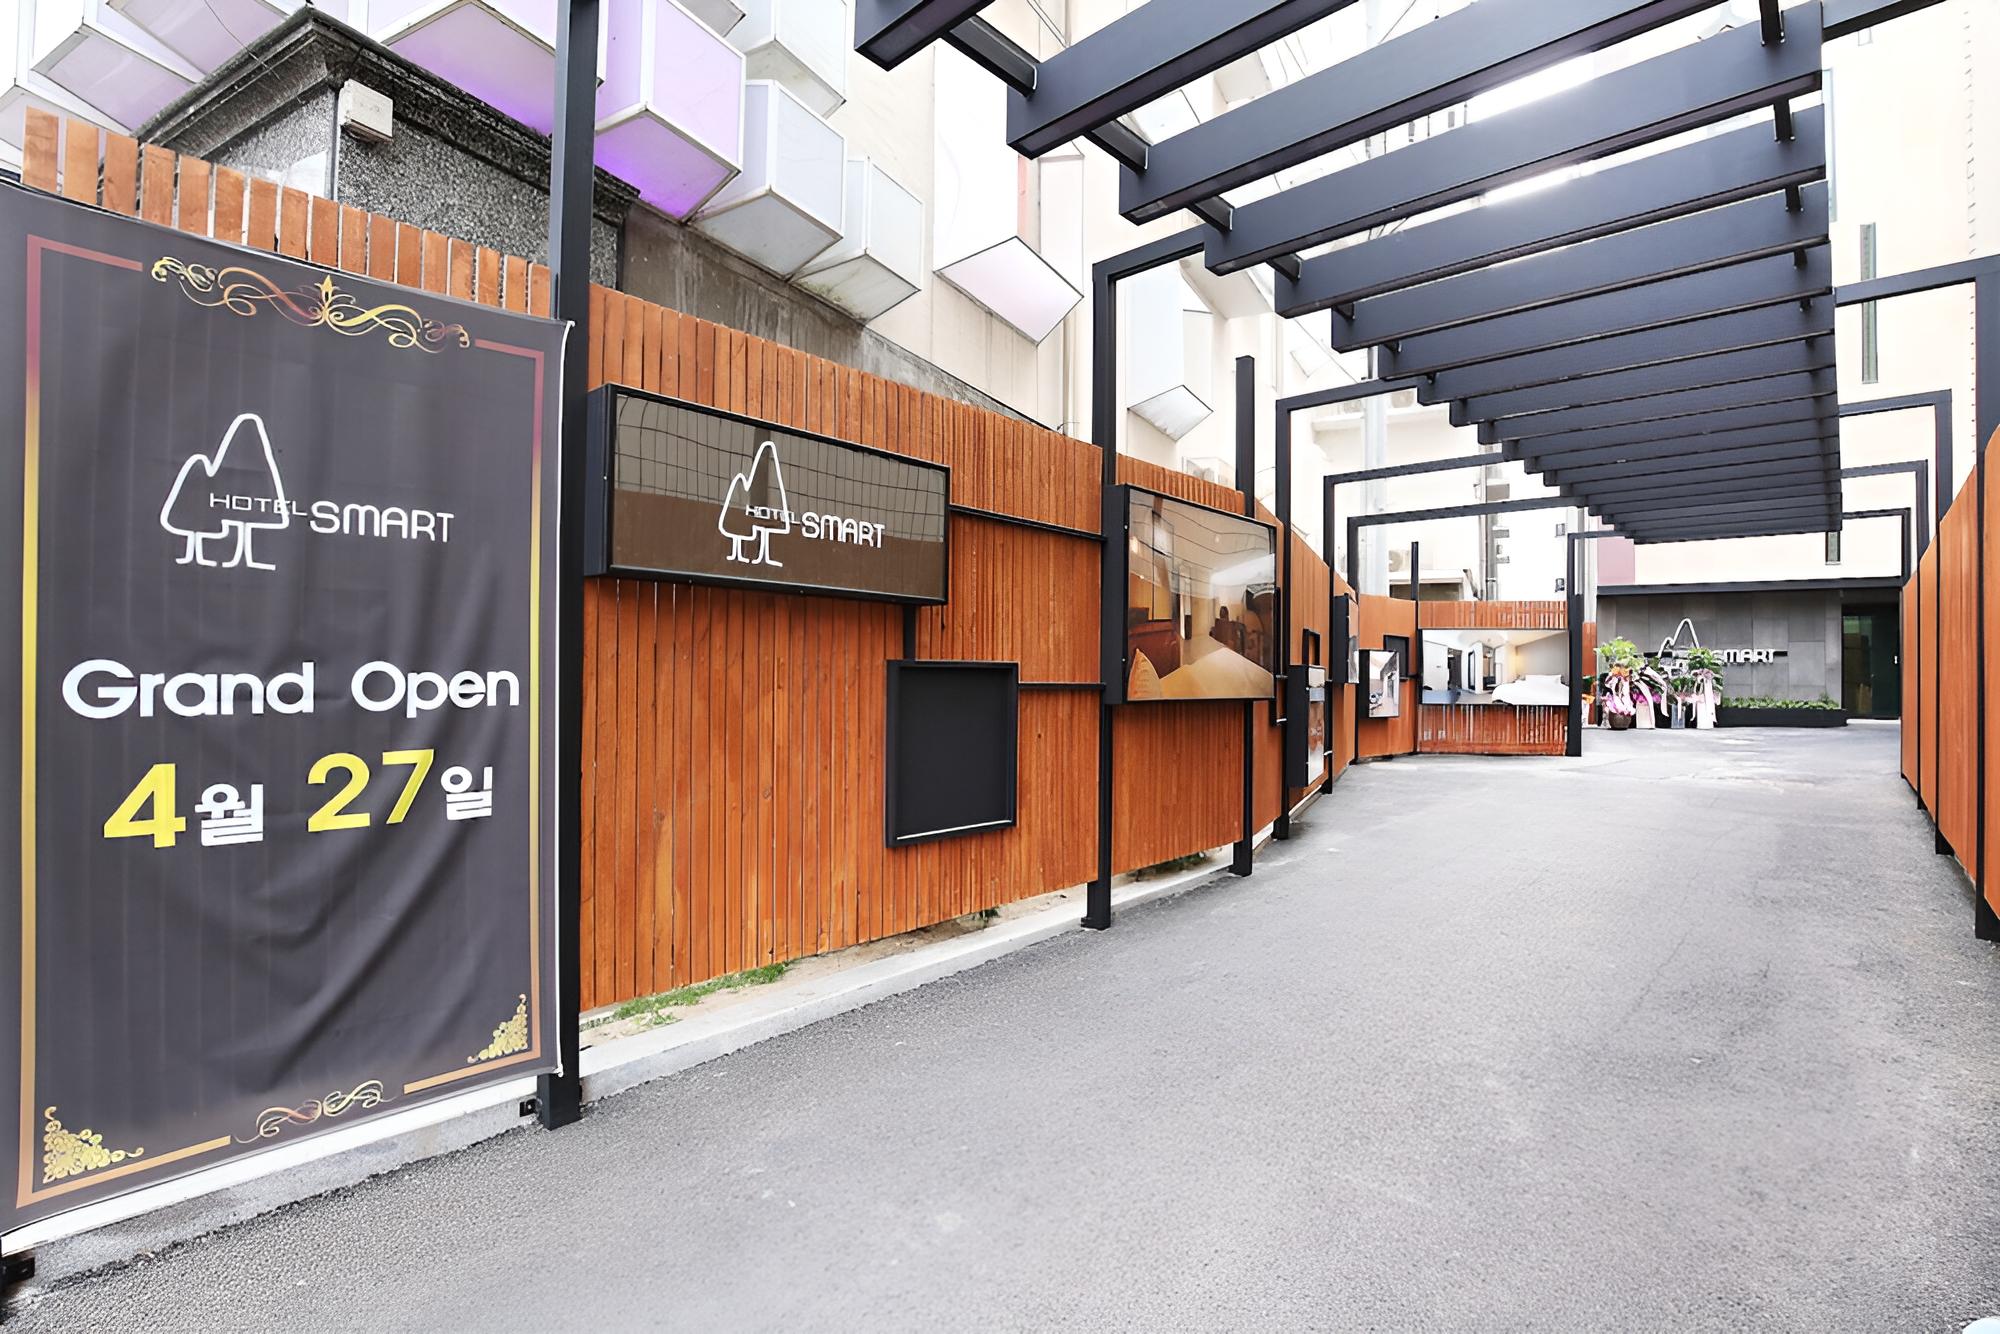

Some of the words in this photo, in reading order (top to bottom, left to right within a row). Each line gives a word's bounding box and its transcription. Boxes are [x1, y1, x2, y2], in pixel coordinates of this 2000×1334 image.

[209, 493, 308, 517] HOTEL
[309, 500, 455, 543] SMART
[801, 511, 886, 549] SMART
[61, 658, 315, 719] Grand
[350, 660, 520, 719] Open
[102, 762, 264, 848] 4월
[306, 748, 493, 833] 27일
